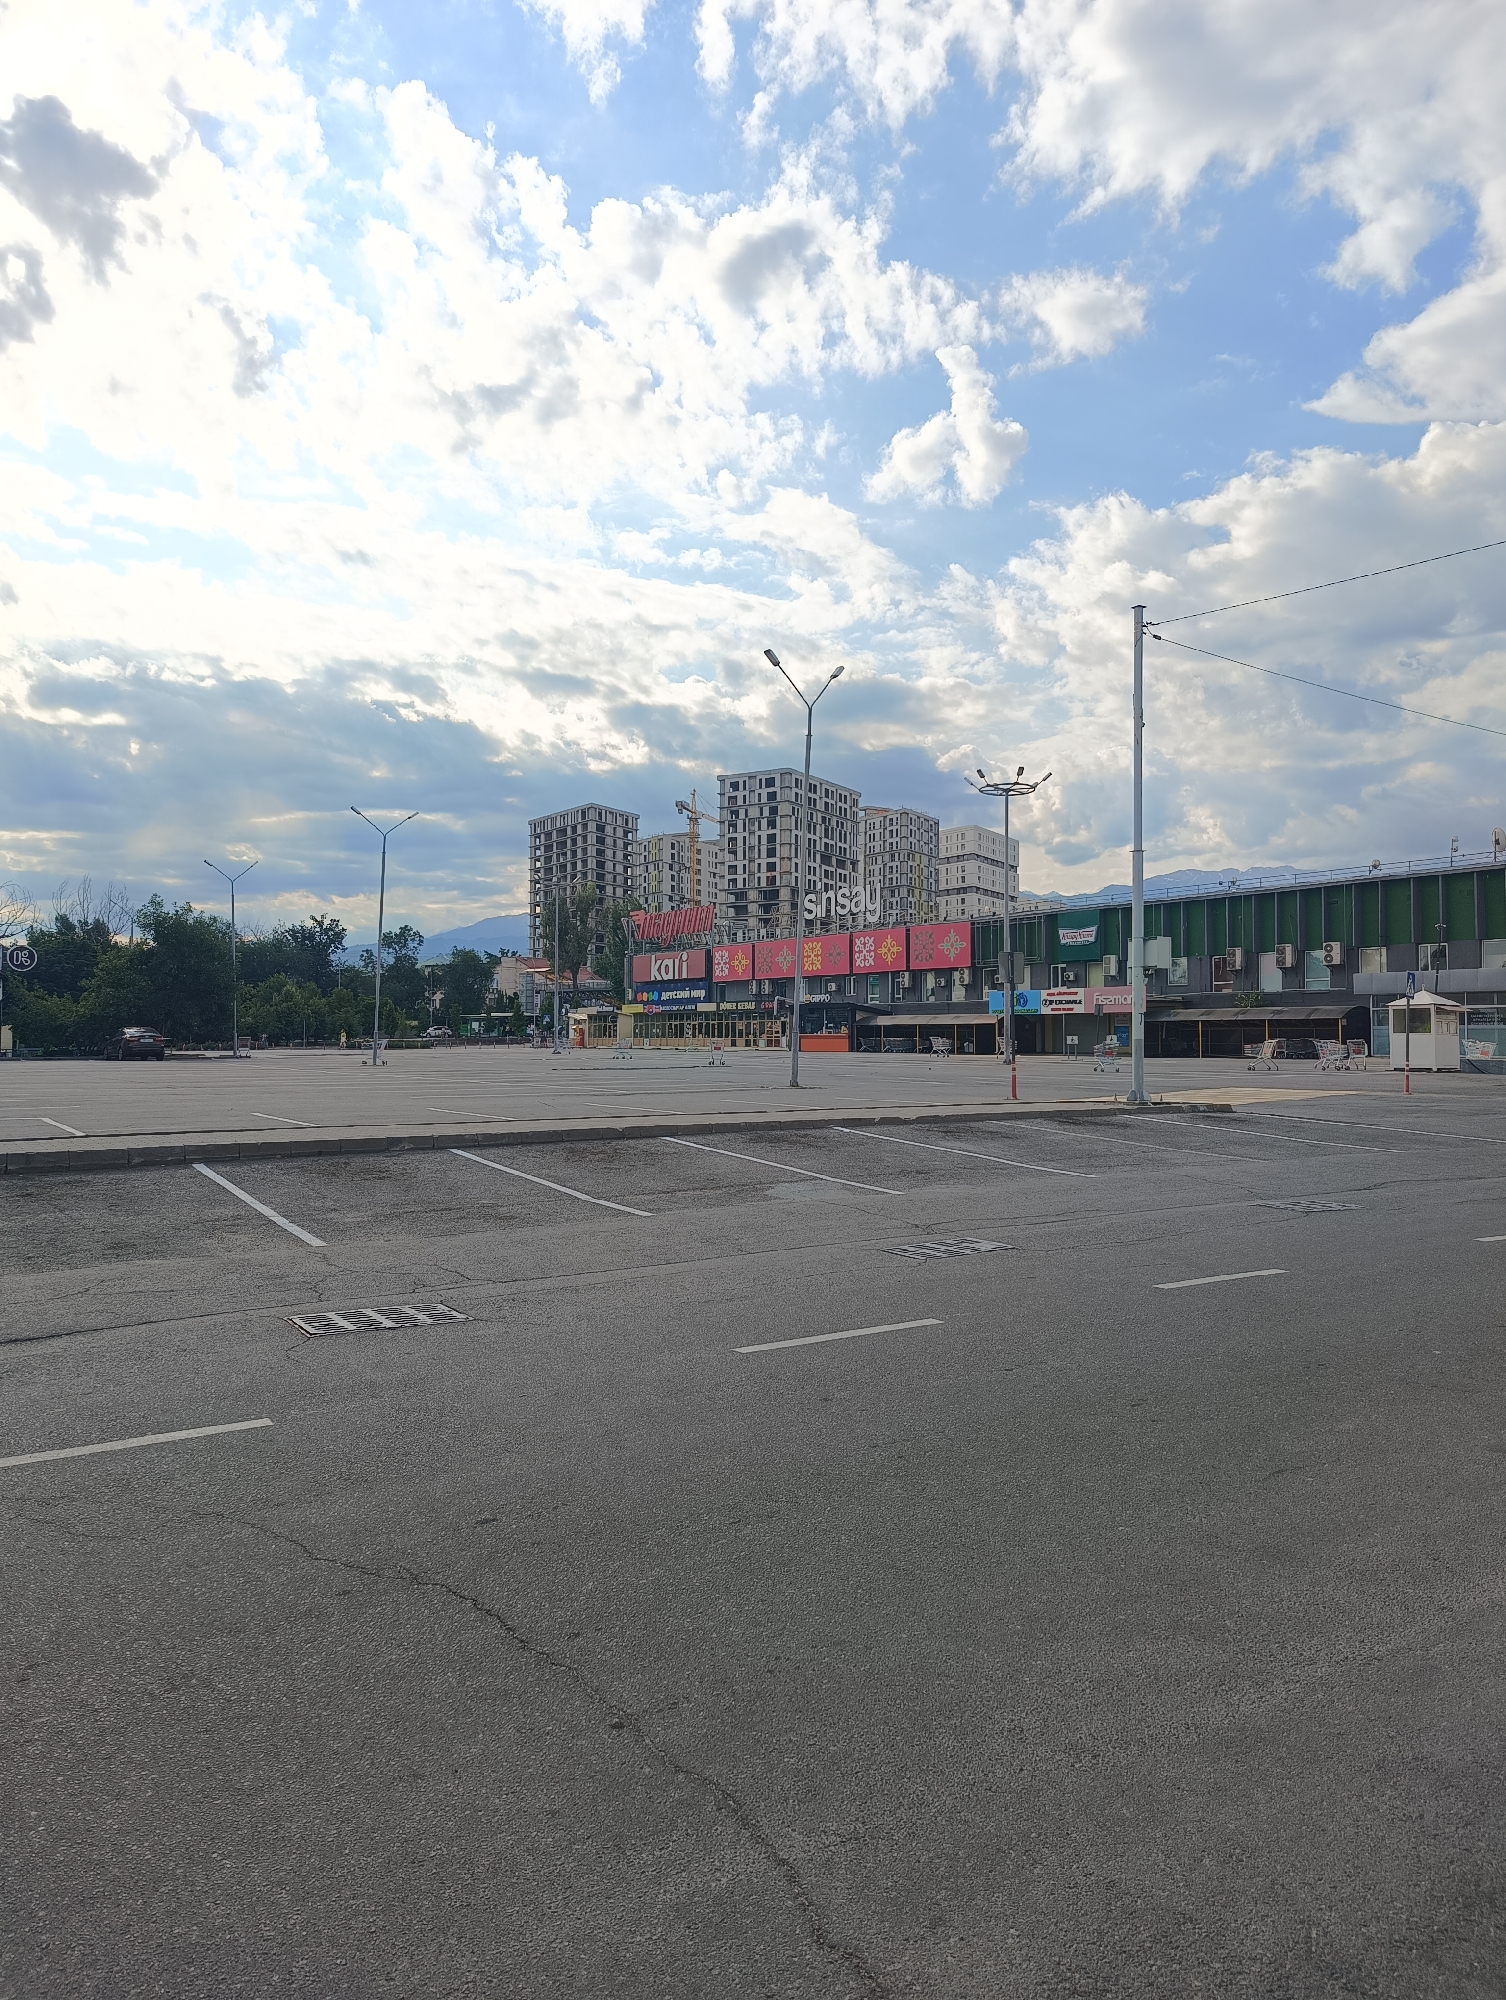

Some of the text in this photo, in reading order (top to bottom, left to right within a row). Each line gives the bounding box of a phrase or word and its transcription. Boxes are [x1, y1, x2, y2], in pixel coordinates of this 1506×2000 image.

[803, 882, 880, 922] sinsay
[630, 905, 714, 947] magnum
[651, 951, 689, 981] kari
[690, 989, 706, 1001] мир
[810, 993, 831, 1003] GIPPO
